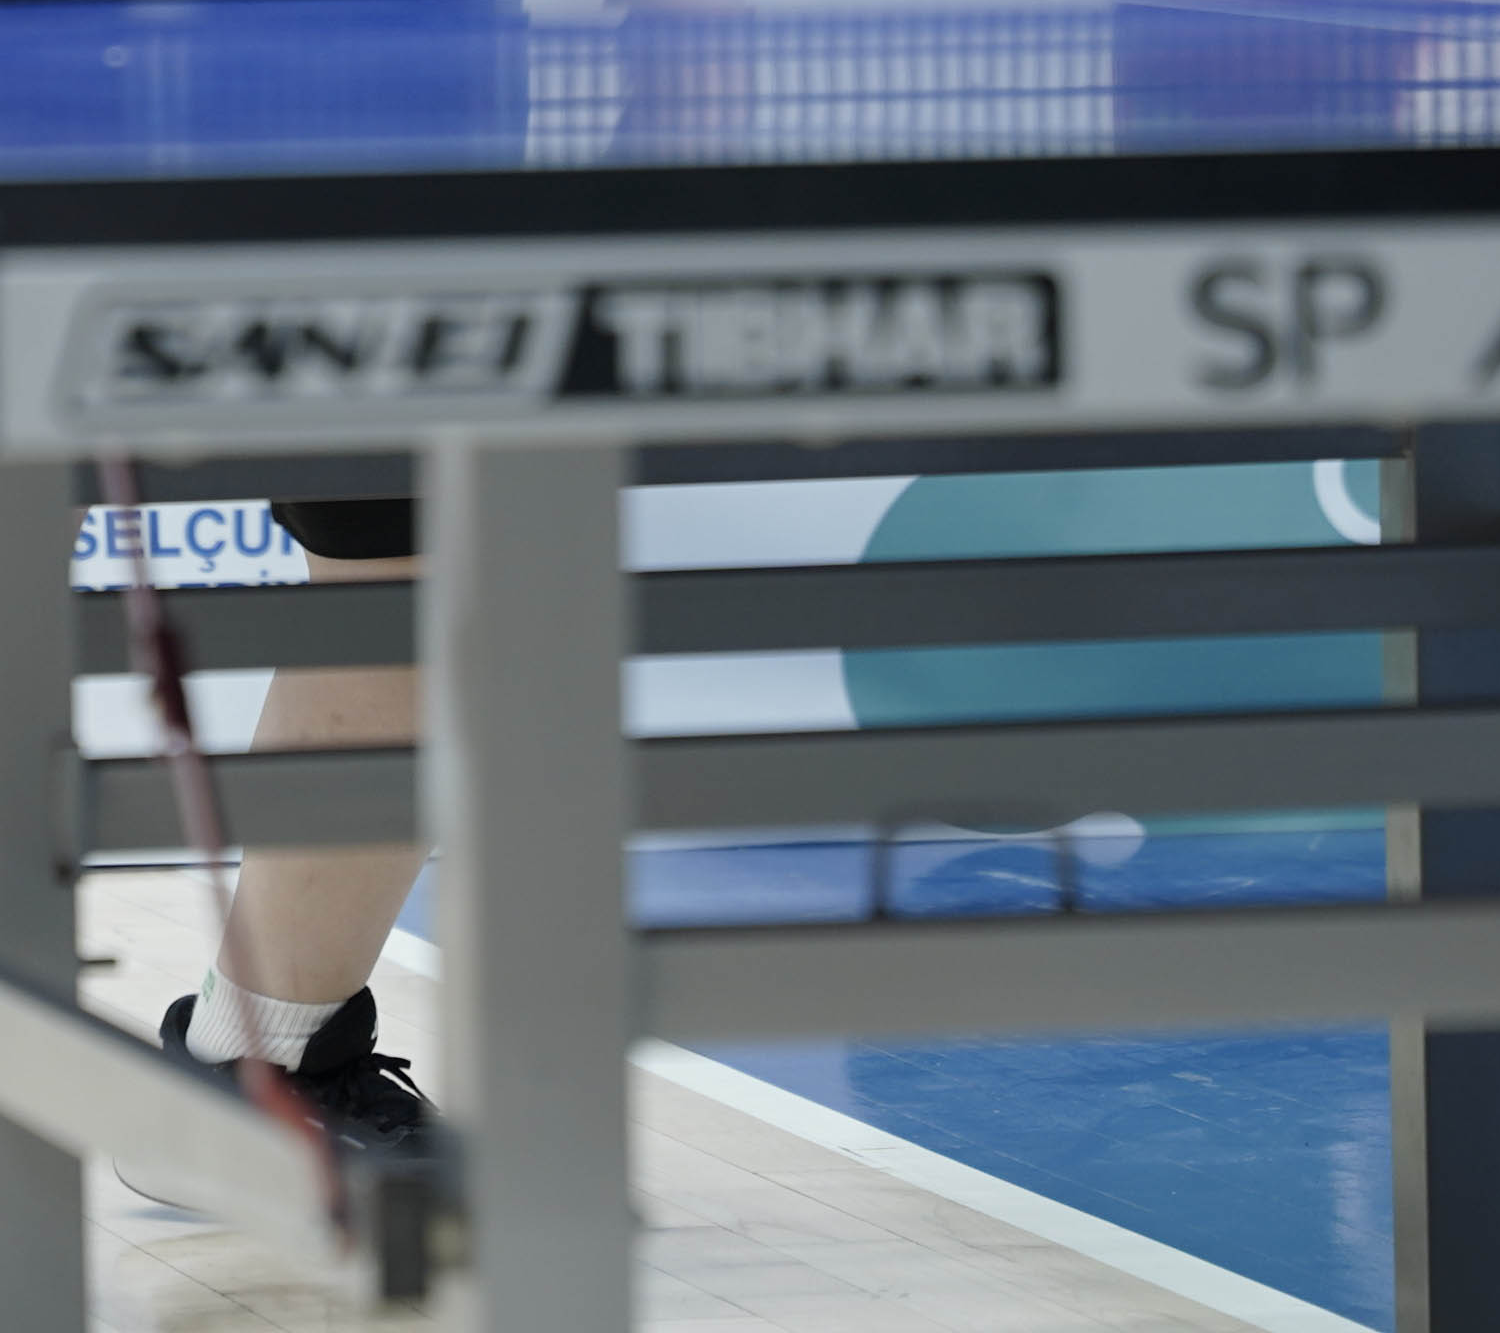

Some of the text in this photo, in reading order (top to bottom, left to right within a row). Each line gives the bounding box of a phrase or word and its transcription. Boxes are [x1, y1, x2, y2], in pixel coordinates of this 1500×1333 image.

[612, 281, 1044, 395] TIBHAR
[1186, 250, 1390, 398] SP
[73, 508, 296, 573] SELÇU
